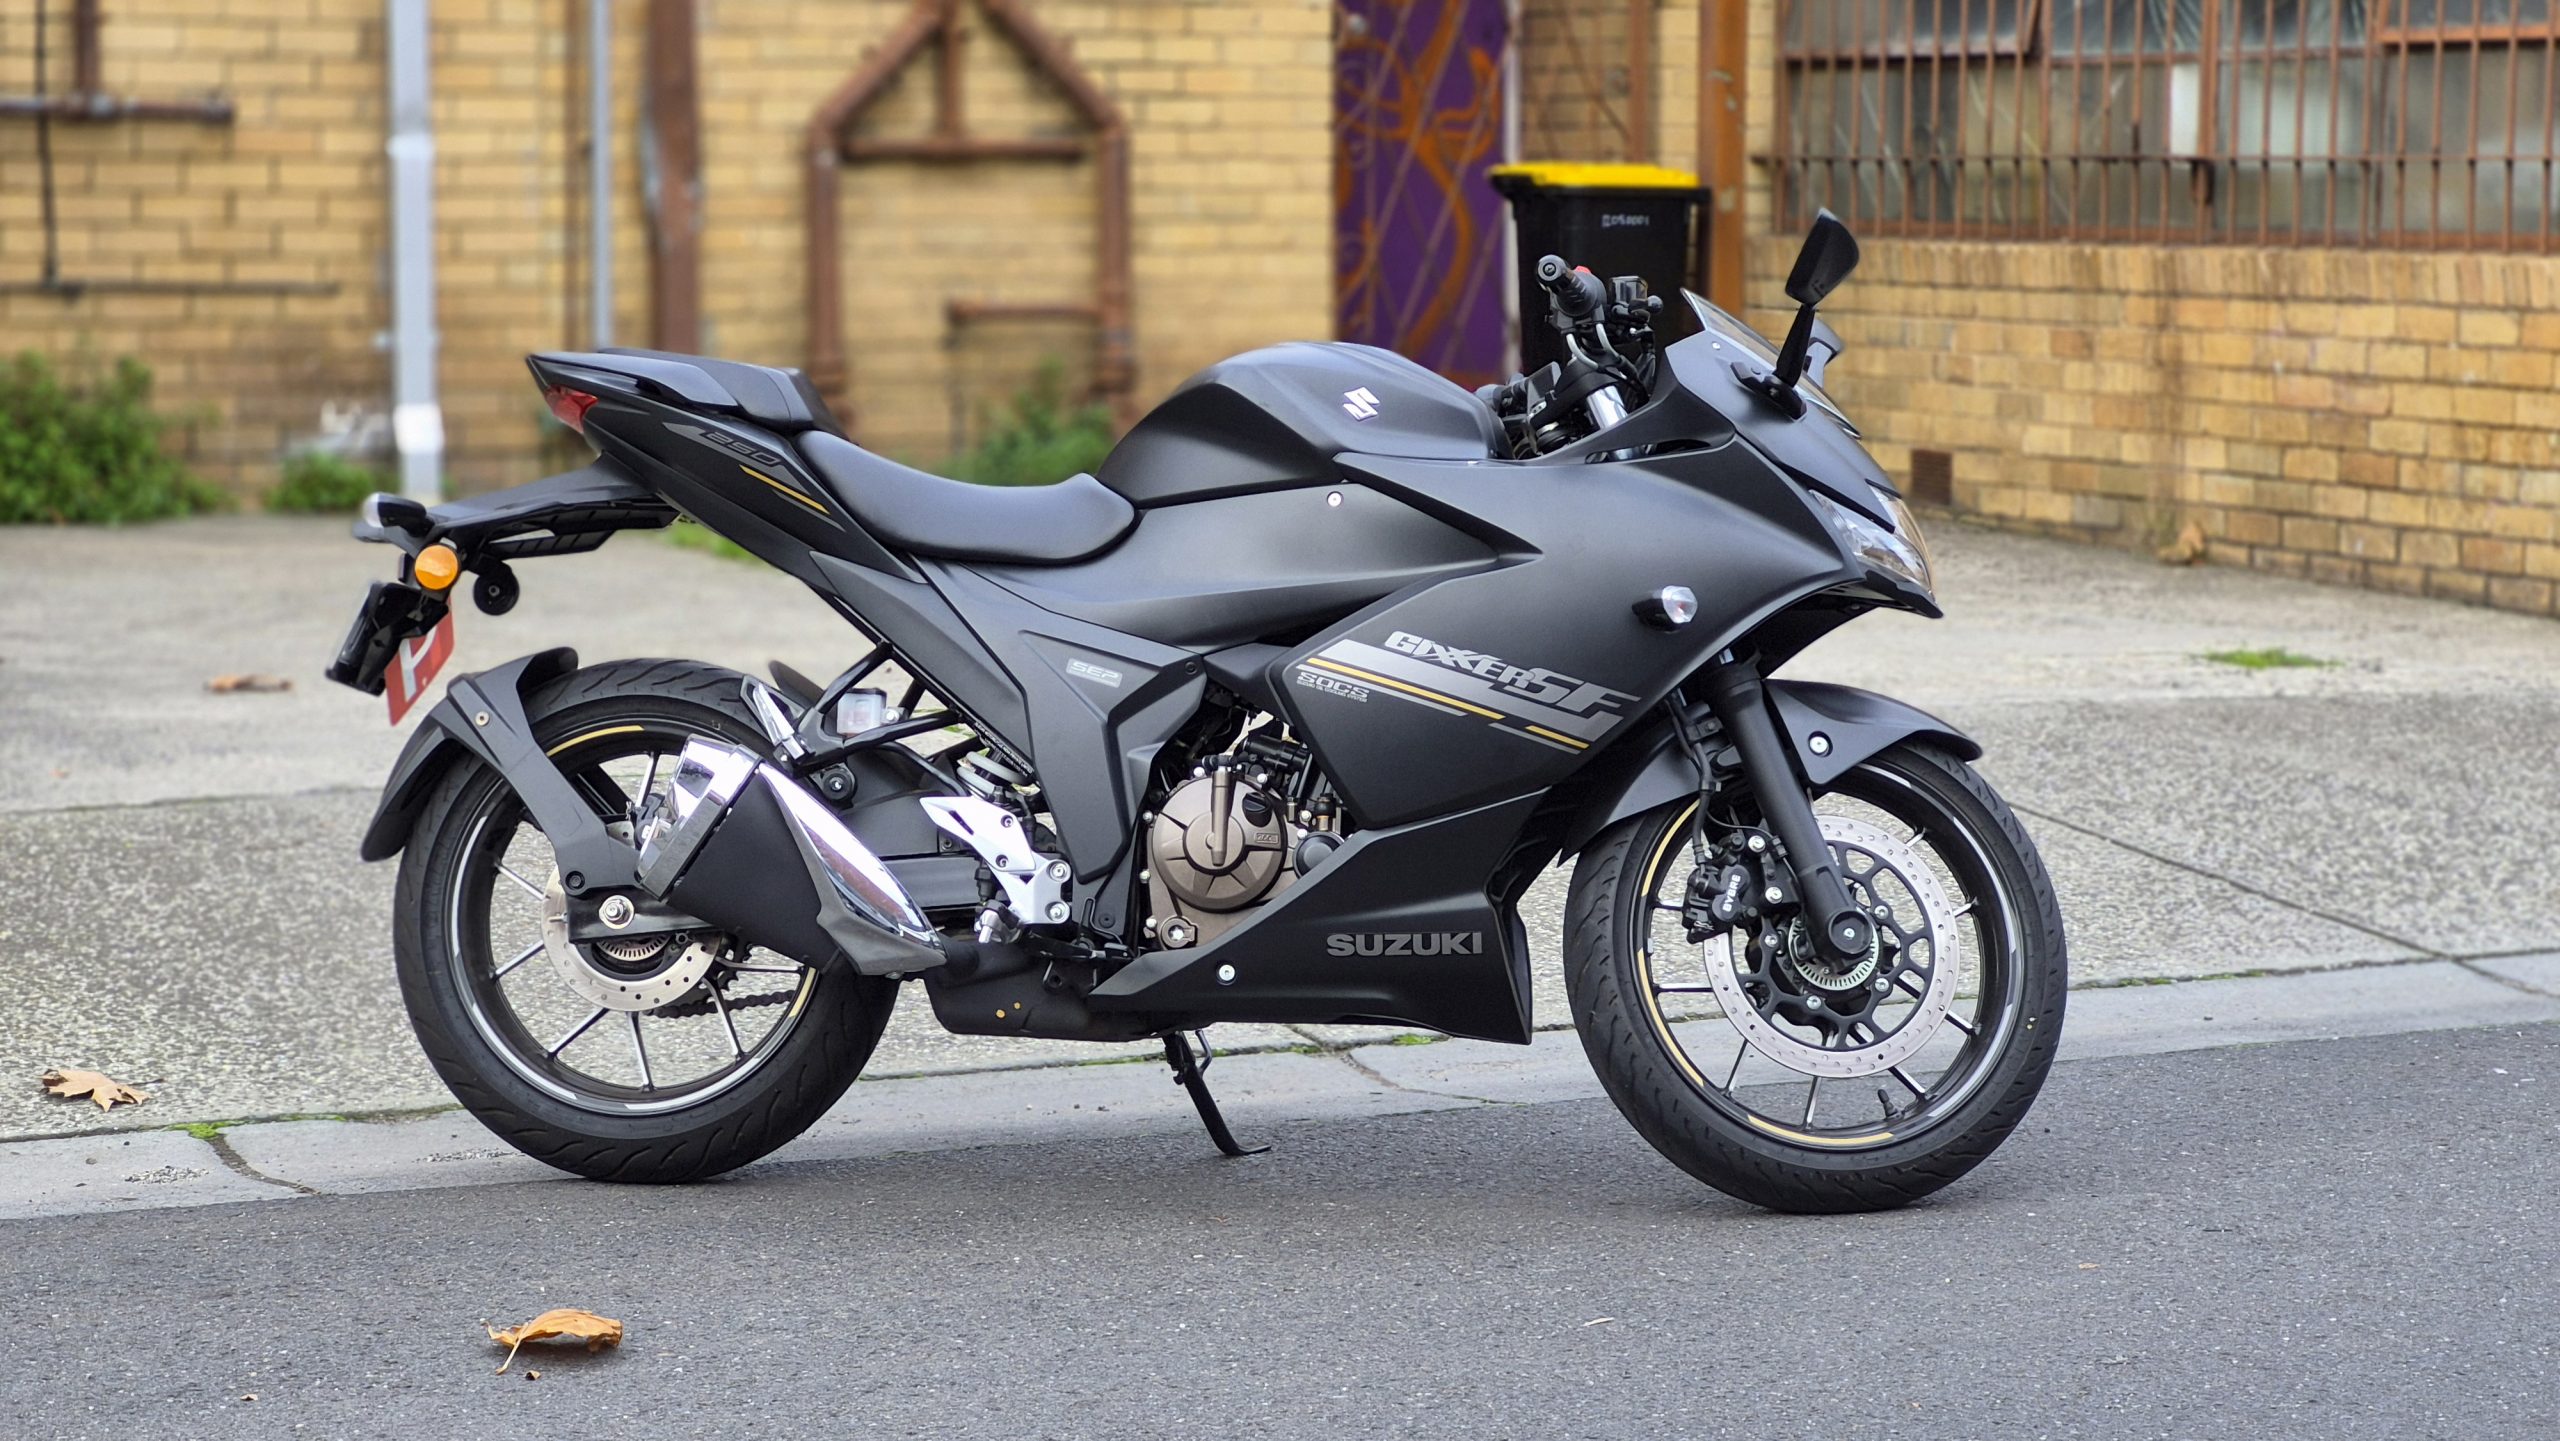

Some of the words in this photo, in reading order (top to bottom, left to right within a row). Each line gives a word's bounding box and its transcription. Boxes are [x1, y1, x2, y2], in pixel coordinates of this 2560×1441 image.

[706, 431, 781, 465] 250
[1070, 661, 1119, 678] SEP
[1384, 630, 1536, 688] GIXXER
[1297, 671, 1370, 698] SOCS
[1722, 874, 1741, 912] BYBRE
[1326, 931, 1482, 956] SUZUKI
